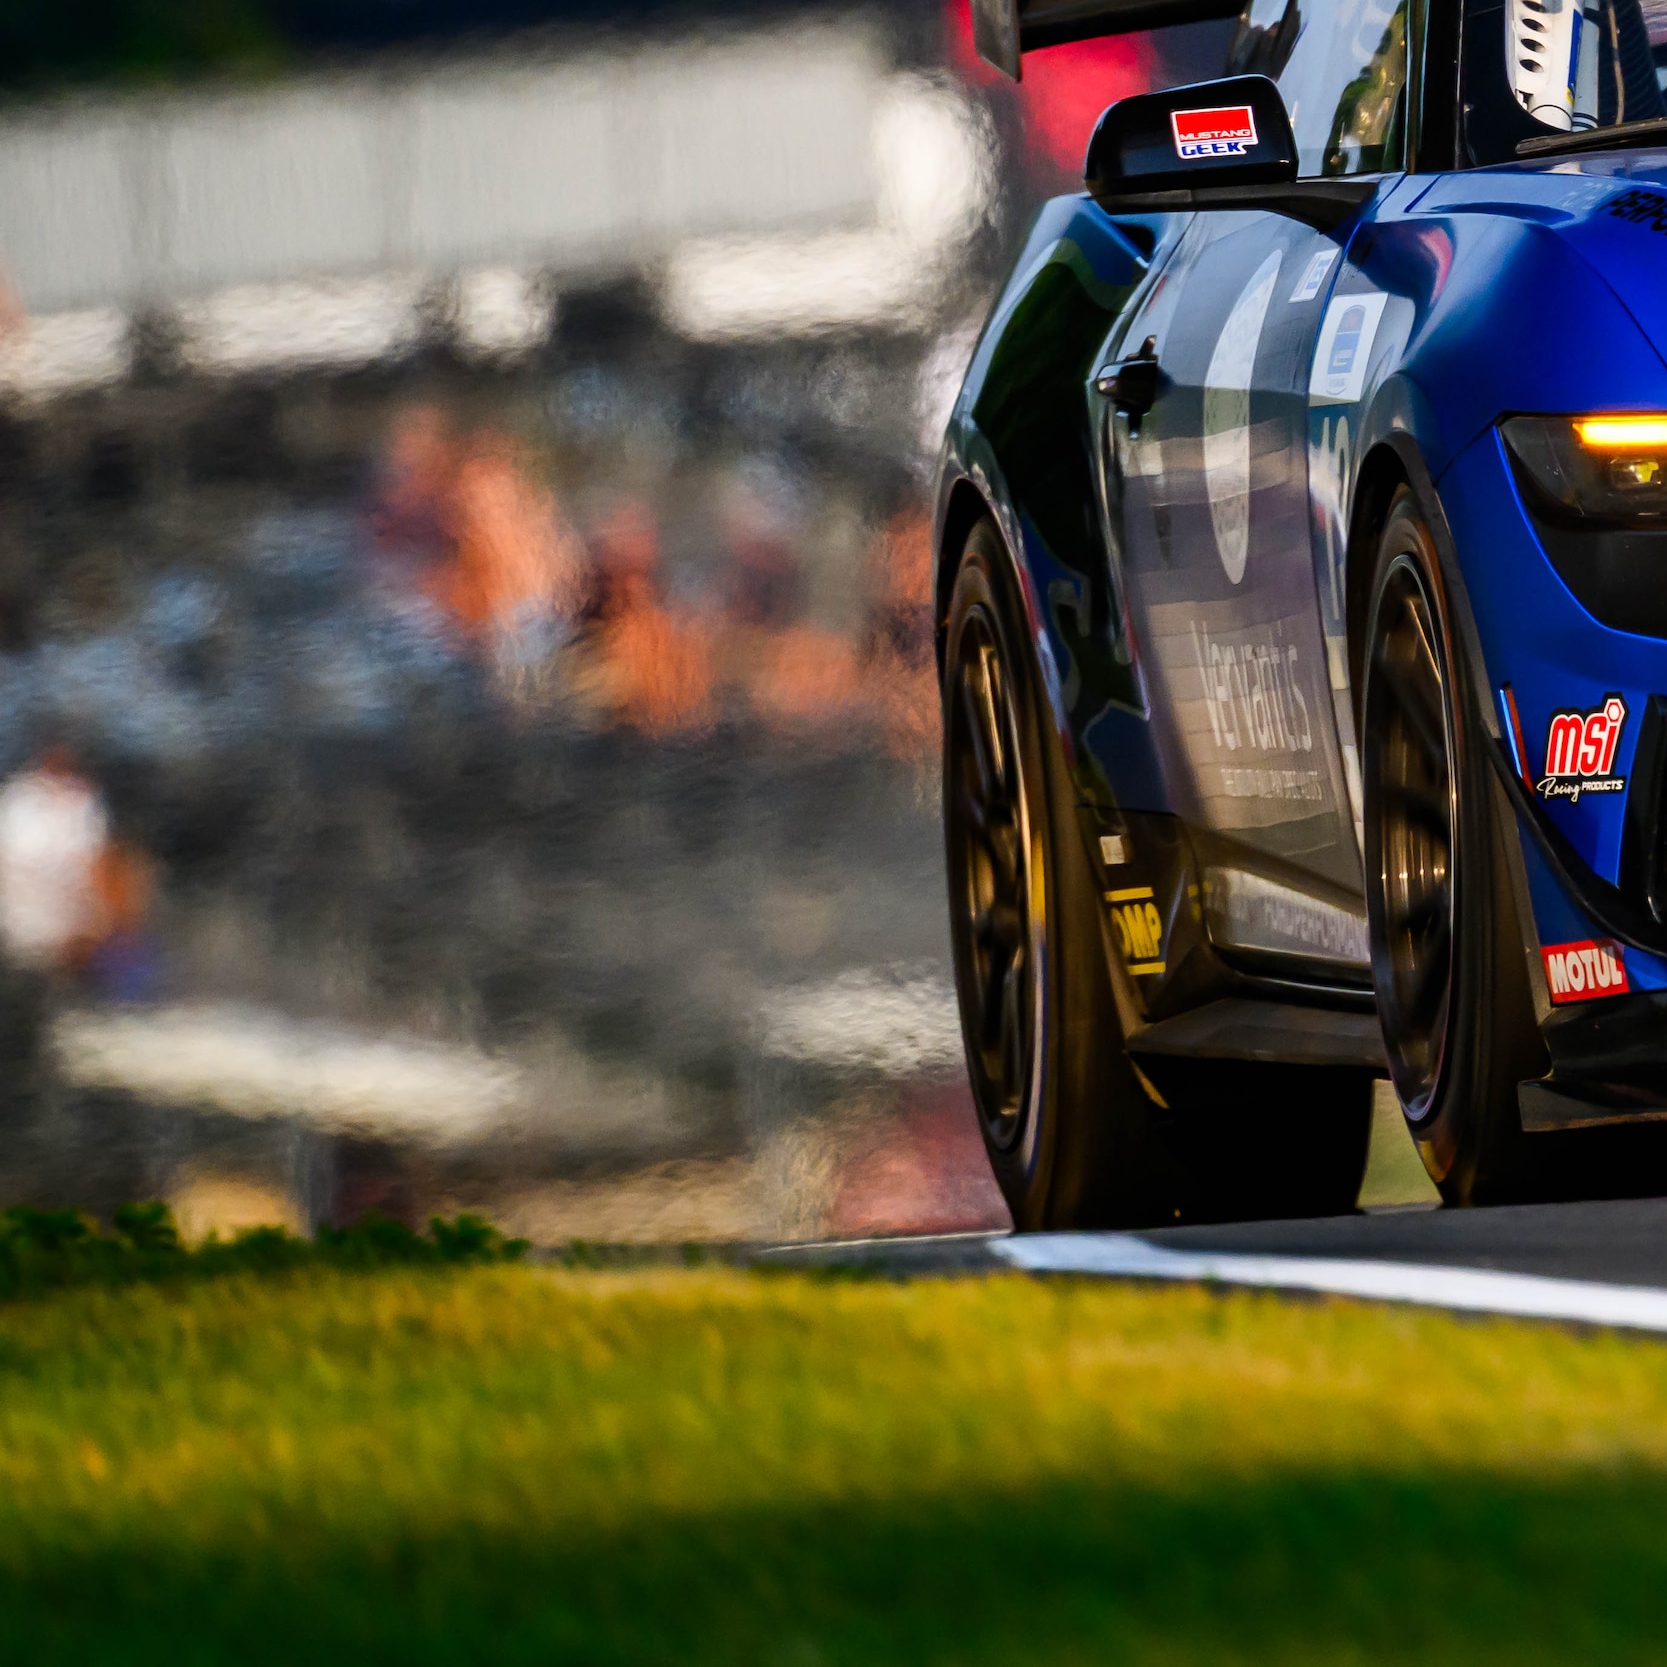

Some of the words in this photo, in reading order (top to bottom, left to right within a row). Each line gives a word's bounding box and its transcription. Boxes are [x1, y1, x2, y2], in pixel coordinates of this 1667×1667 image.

[1179, 129, 1251, 142] MUSTANG
[1181, 141, 1242, 157] GEEK
[1536, 776, 1581, 803] Racing
[1581, 779, 1625, 792] PRODUCTS
[1110, 901, 1163, 959] OMP
[1547, 945, 1623, 995] MOTUL
